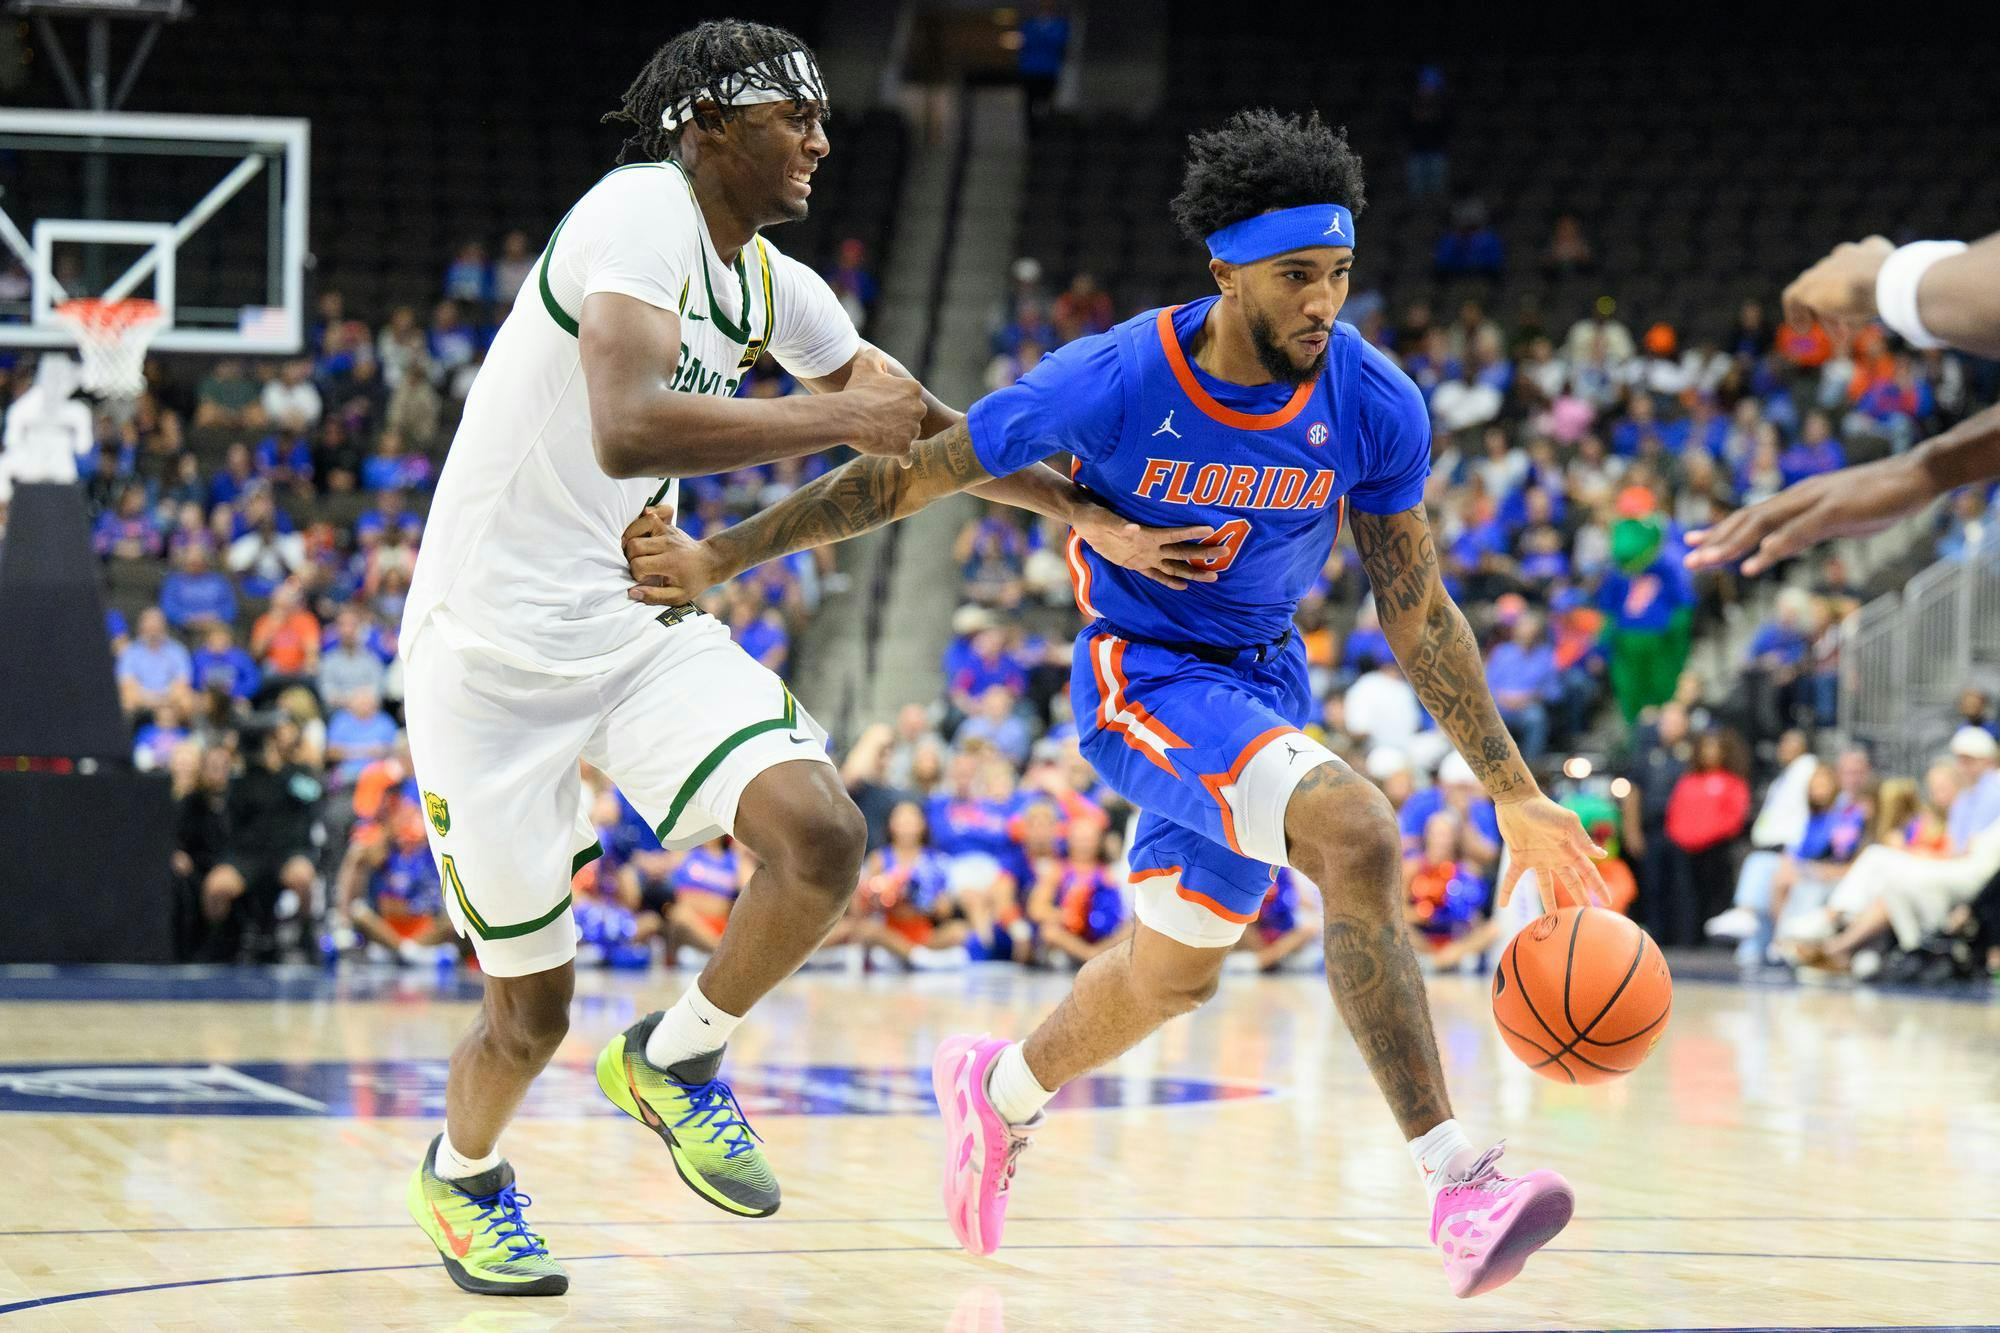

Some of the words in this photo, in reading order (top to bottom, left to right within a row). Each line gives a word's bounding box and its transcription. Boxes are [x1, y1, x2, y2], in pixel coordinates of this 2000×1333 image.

[1309, 424, 1327, 445] SEC
[1132, 457, 1335, 510] FLORIDA
[1186, 518, 1253, 572] 0
